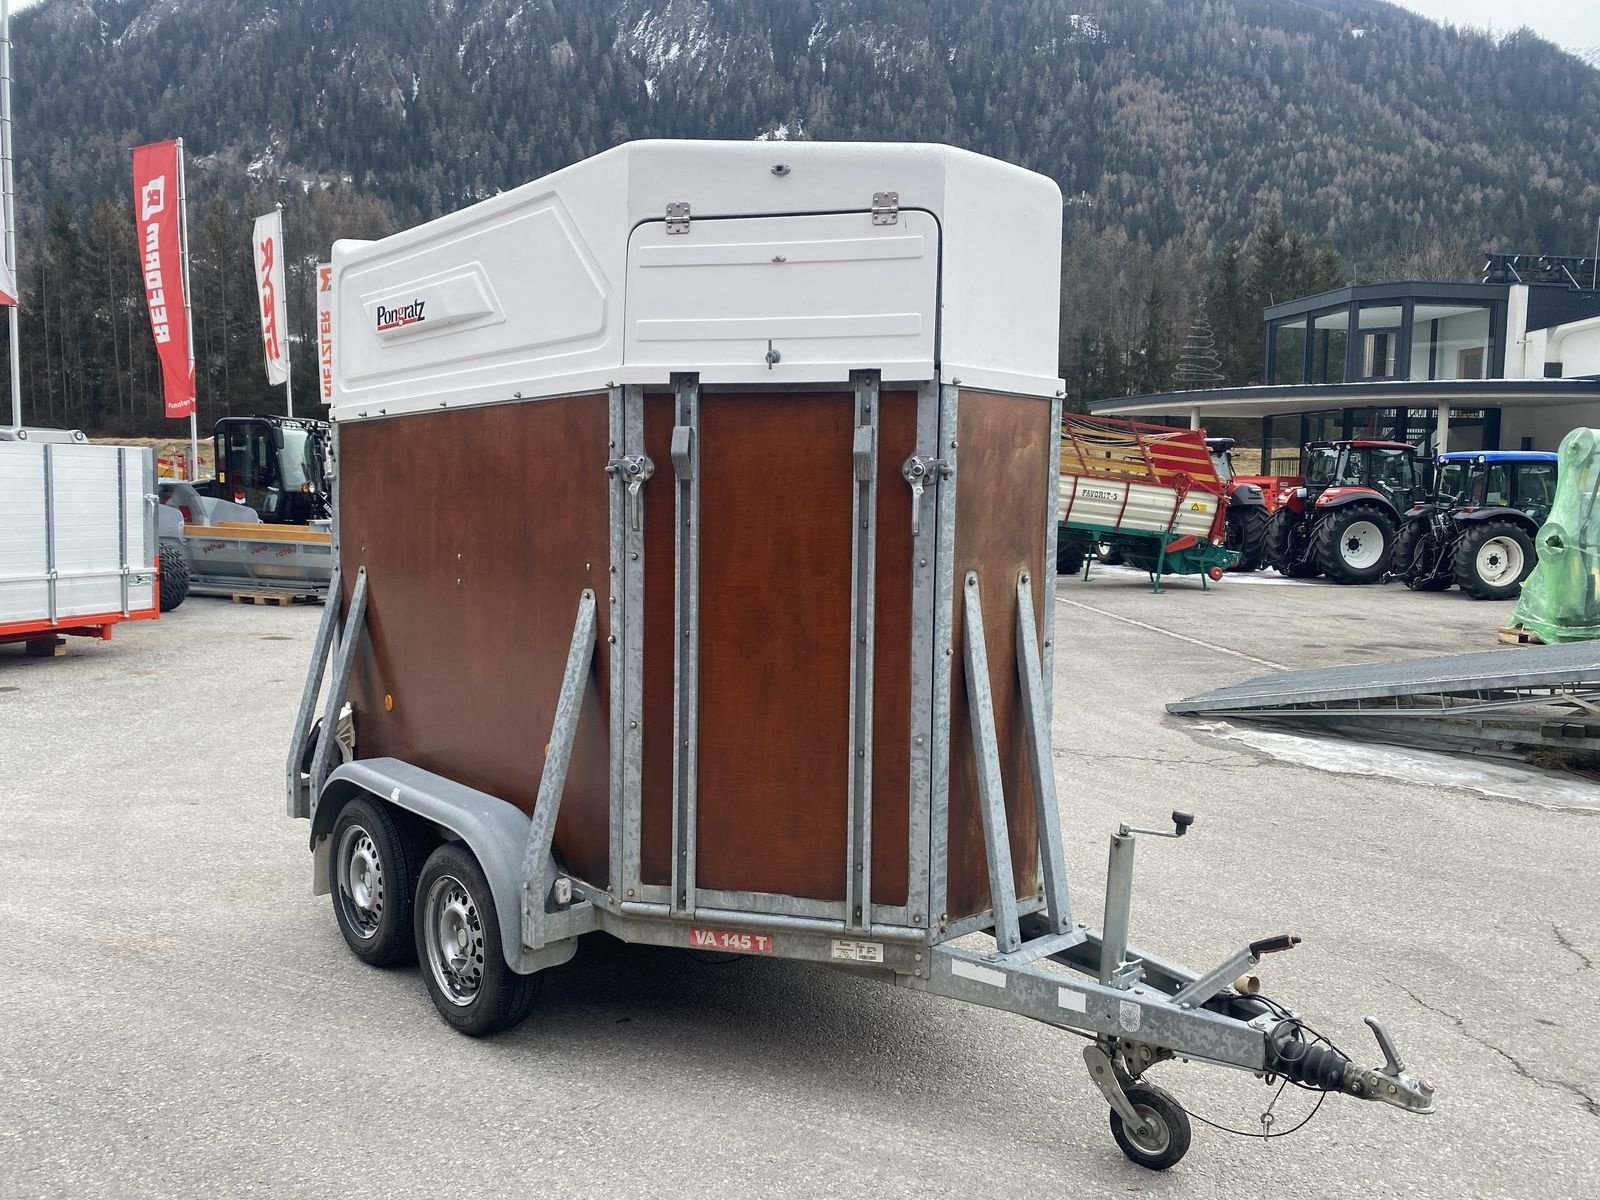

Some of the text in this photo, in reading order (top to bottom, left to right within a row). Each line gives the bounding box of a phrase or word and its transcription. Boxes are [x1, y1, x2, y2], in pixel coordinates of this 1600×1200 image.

[377, 298, 425, 326] Pongratz
[694, 930, 768, 951] VA 145 T
